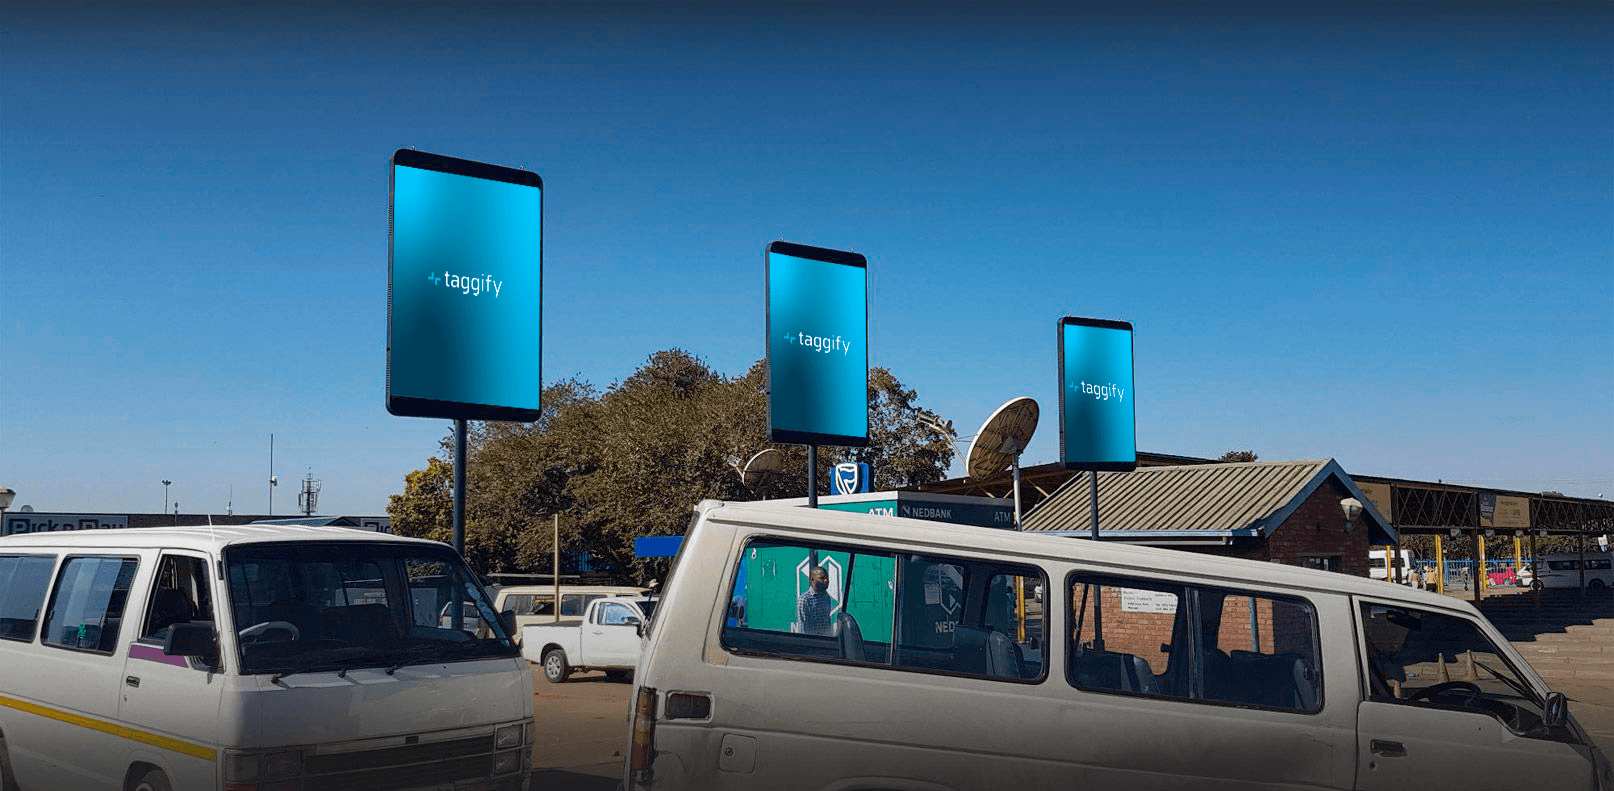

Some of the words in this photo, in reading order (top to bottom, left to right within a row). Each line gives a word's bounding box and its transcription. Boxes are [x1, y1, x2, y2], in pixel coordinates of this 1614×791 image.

[444, 271, 503, 298] taggify
[799, 331, 851, 357] taggify
[1080, 380, 1125, 403] taggify
[912, 507, 952, 519] NEDBANK
[993, 511, 1011, 522] ATM
